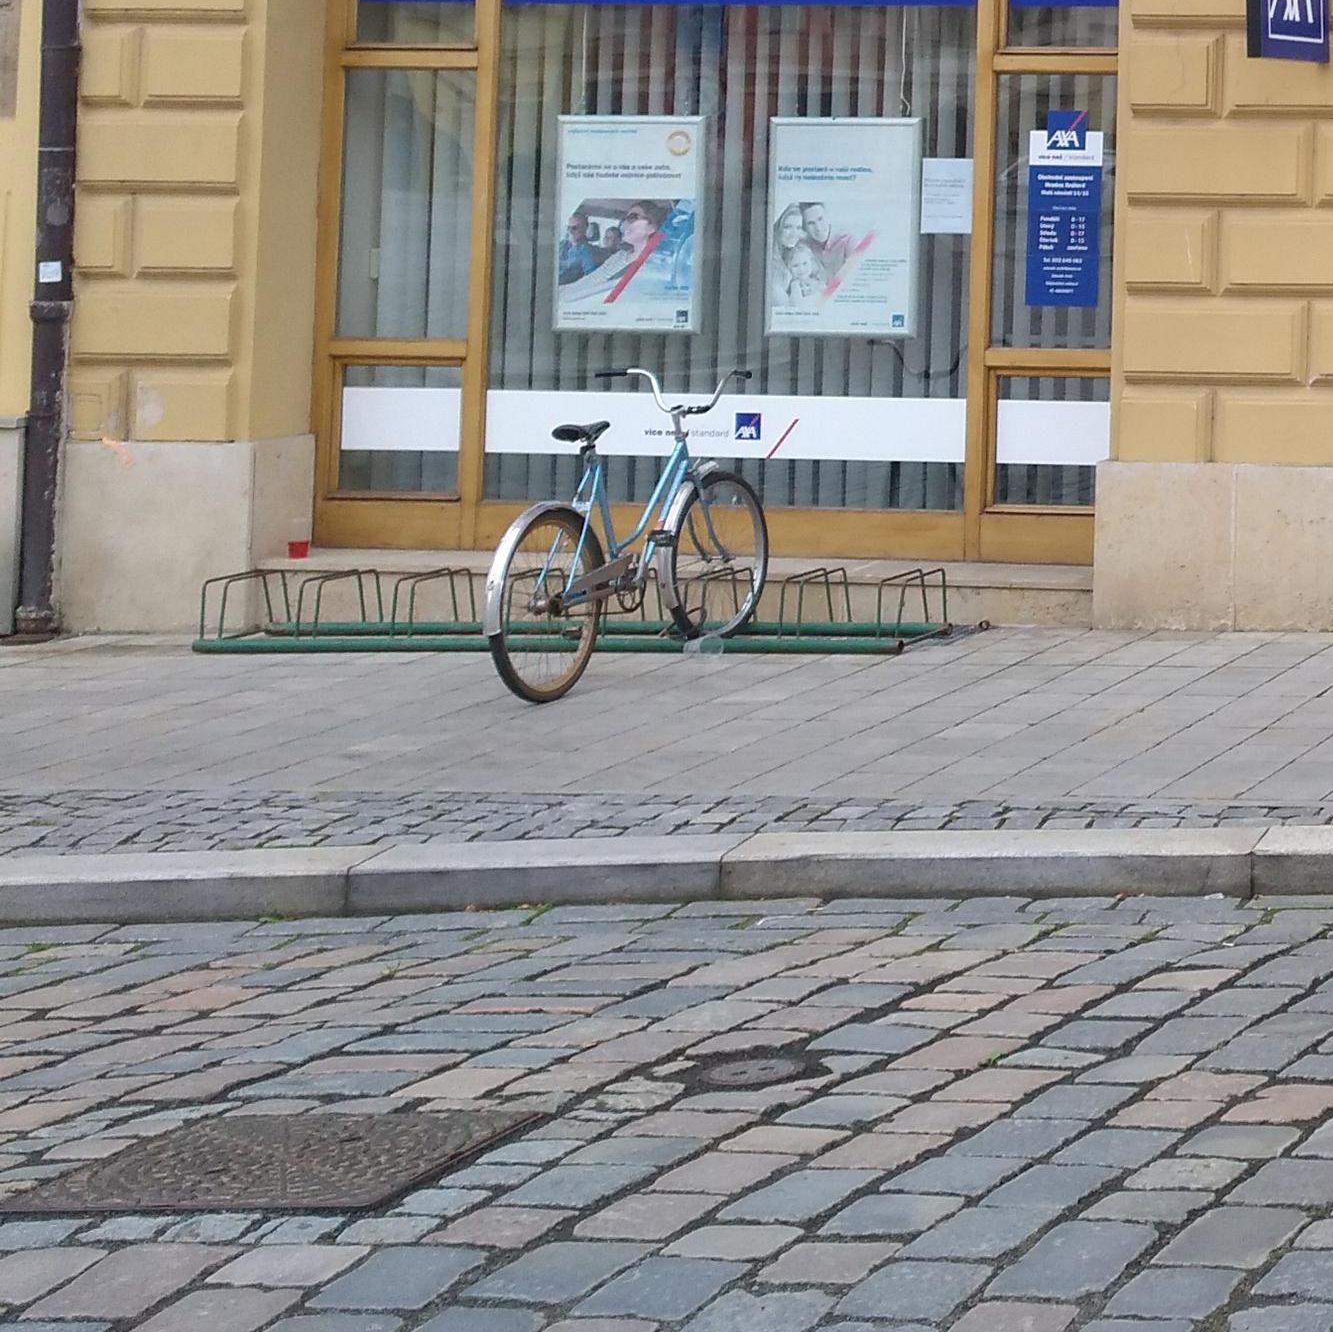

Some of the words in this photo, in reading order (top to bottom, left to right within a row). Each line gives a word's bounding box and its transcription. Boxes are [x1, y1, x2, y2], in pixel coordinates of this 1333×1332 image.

[1046, 130, 1080, 148] AXA
[690, 428, 730, 438] standard
[734, 426, 758, 439] AXA
